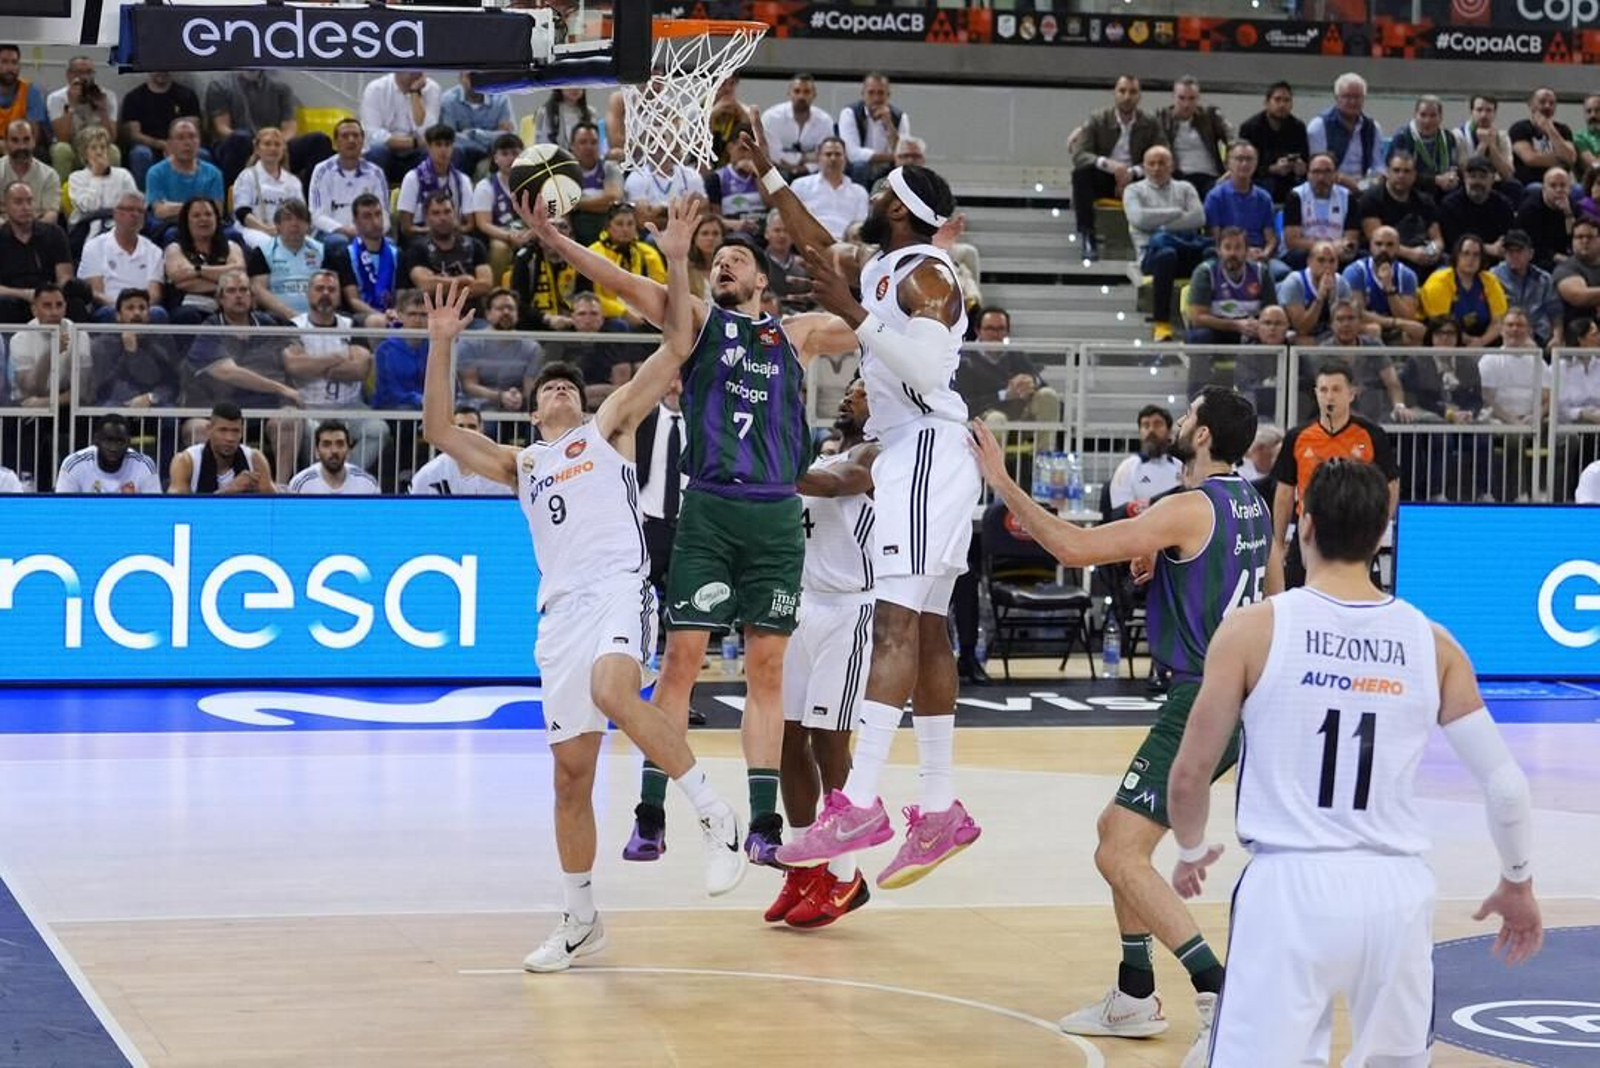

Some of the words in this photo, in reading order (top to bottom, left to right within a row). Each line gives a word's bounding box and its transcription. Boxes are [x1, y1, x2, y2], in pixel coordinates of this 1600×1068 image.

[182, 9, 424, 59] endesa
[810, 11, 925, 33] #CopaACB
[1436, 32, 1542, 54] #CopaACB
[733, 412, 754, 440] 7
[548, 495, 567, 525] 9
[1306, 630, 1405, 665] HEZONJA
[1301, 671, 1404, 695] AUTOHERO
[1316, 708, 1376, 811] 11
